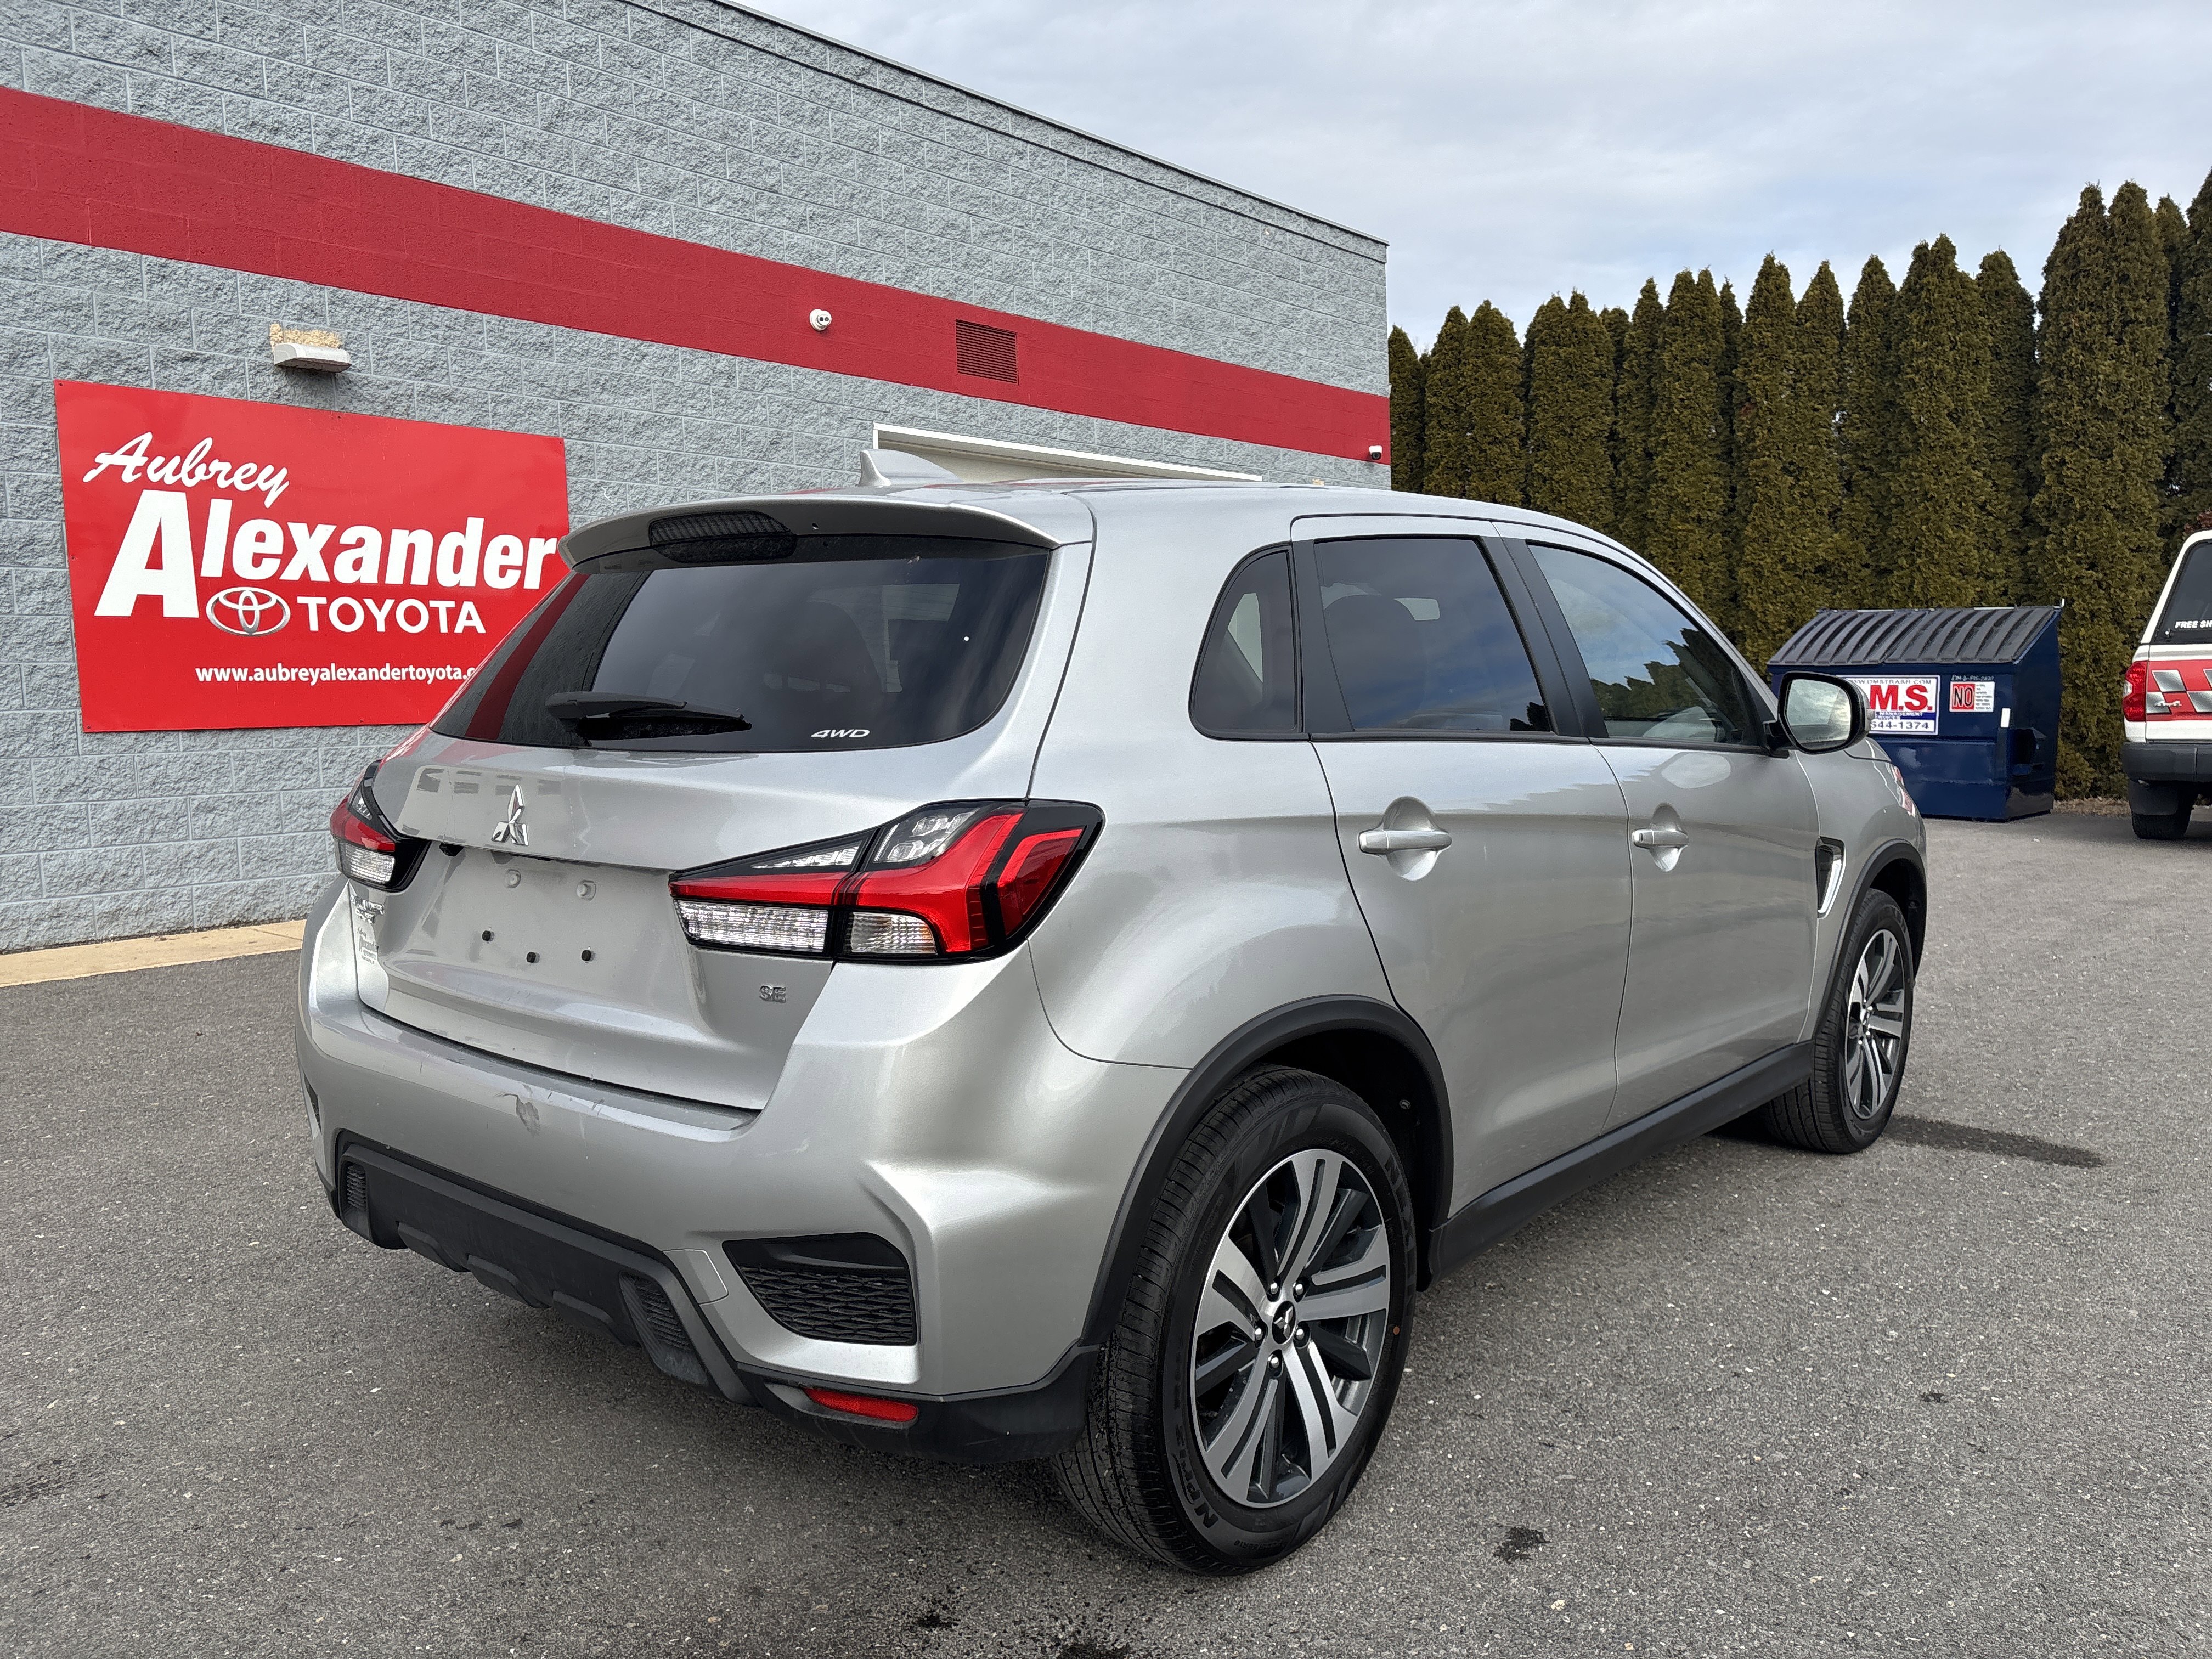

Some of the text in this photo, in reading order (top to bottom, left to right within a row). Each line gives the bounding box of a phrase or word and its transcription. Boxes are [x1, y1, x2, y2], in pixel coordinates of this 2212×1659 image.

[82, 431, 290, 509] Aubrey
[94, 489, 558, 619] Alexander
[297, 596, 487, 634] TOYOTA
[2175, 620, 2199, 629] FREE
[1953, 685, 1974, 708] NO
[810, 729, 871, 738] 4WD
[759, 985, 786, 1003] SE
